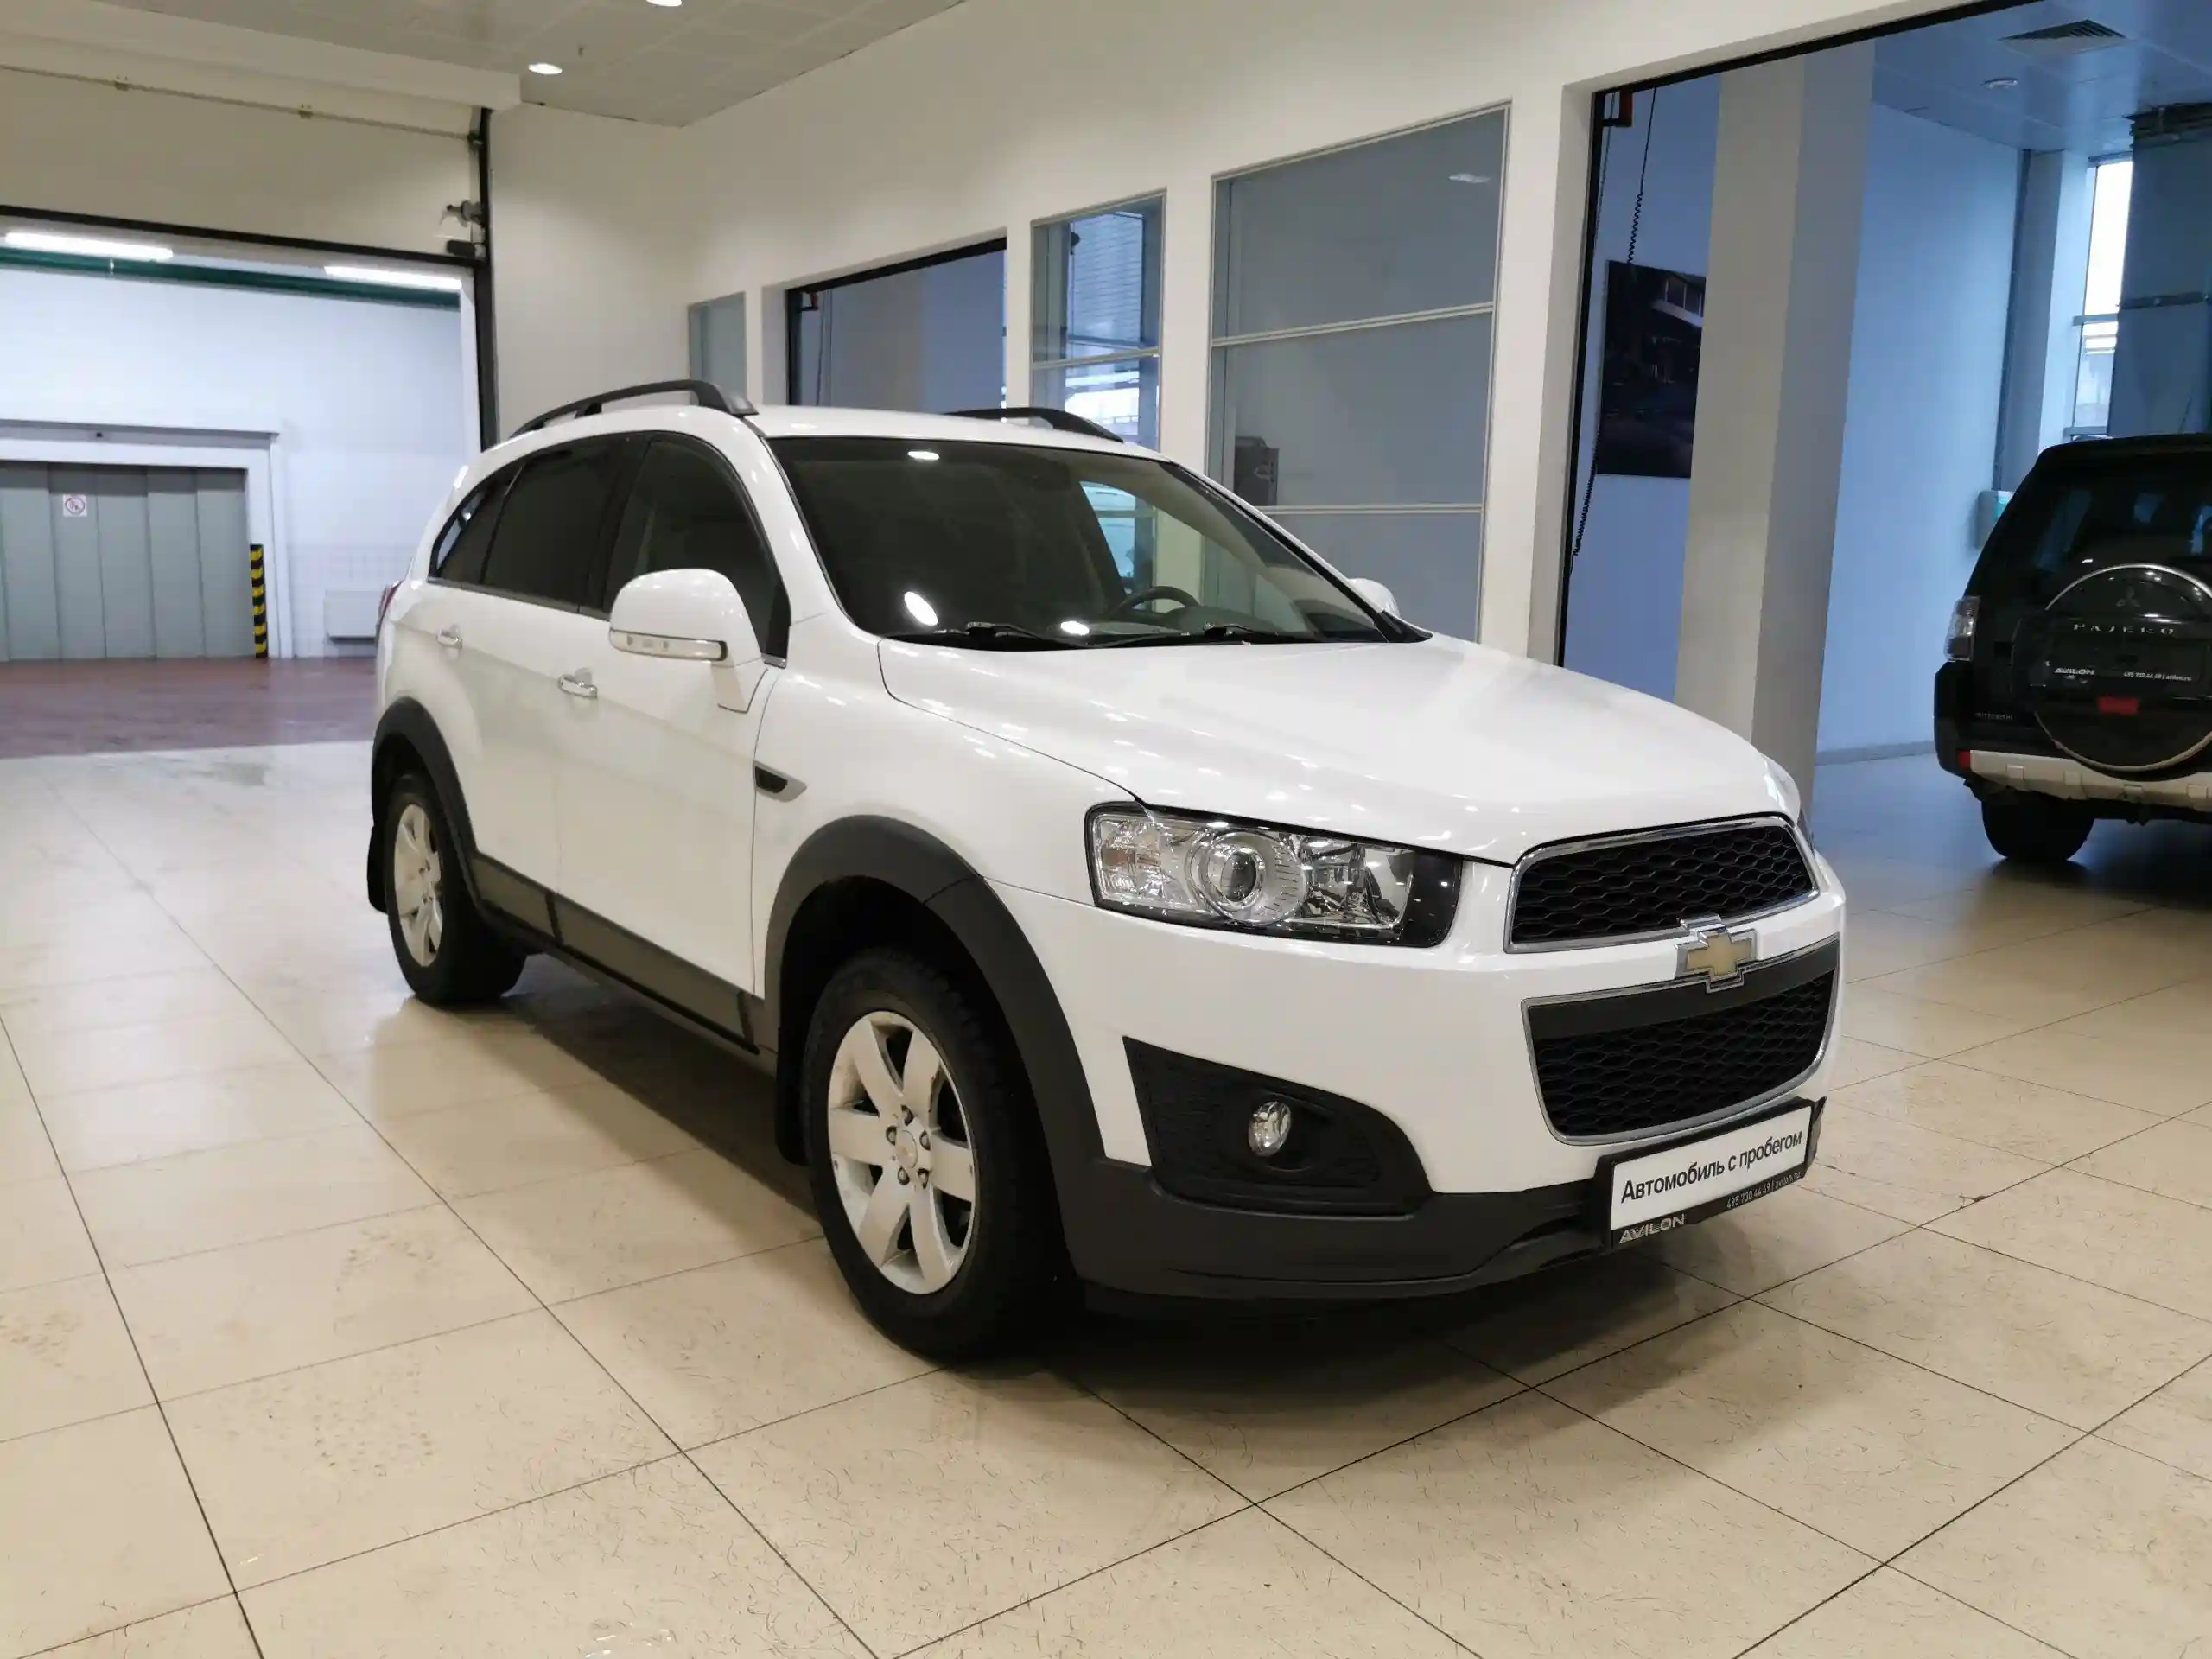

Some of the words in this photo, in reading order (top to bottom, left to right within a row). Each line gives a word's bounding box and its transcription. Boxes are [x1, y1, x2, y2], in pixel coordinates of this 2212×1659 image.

[1621, 1161, 1725, 1204] Автомобиль
[1728, 1155, 1737, 1171] с
[1739, 1131, 1802, 1169] пробегом
[1619, 1213, 1686, 1244] AVILON
